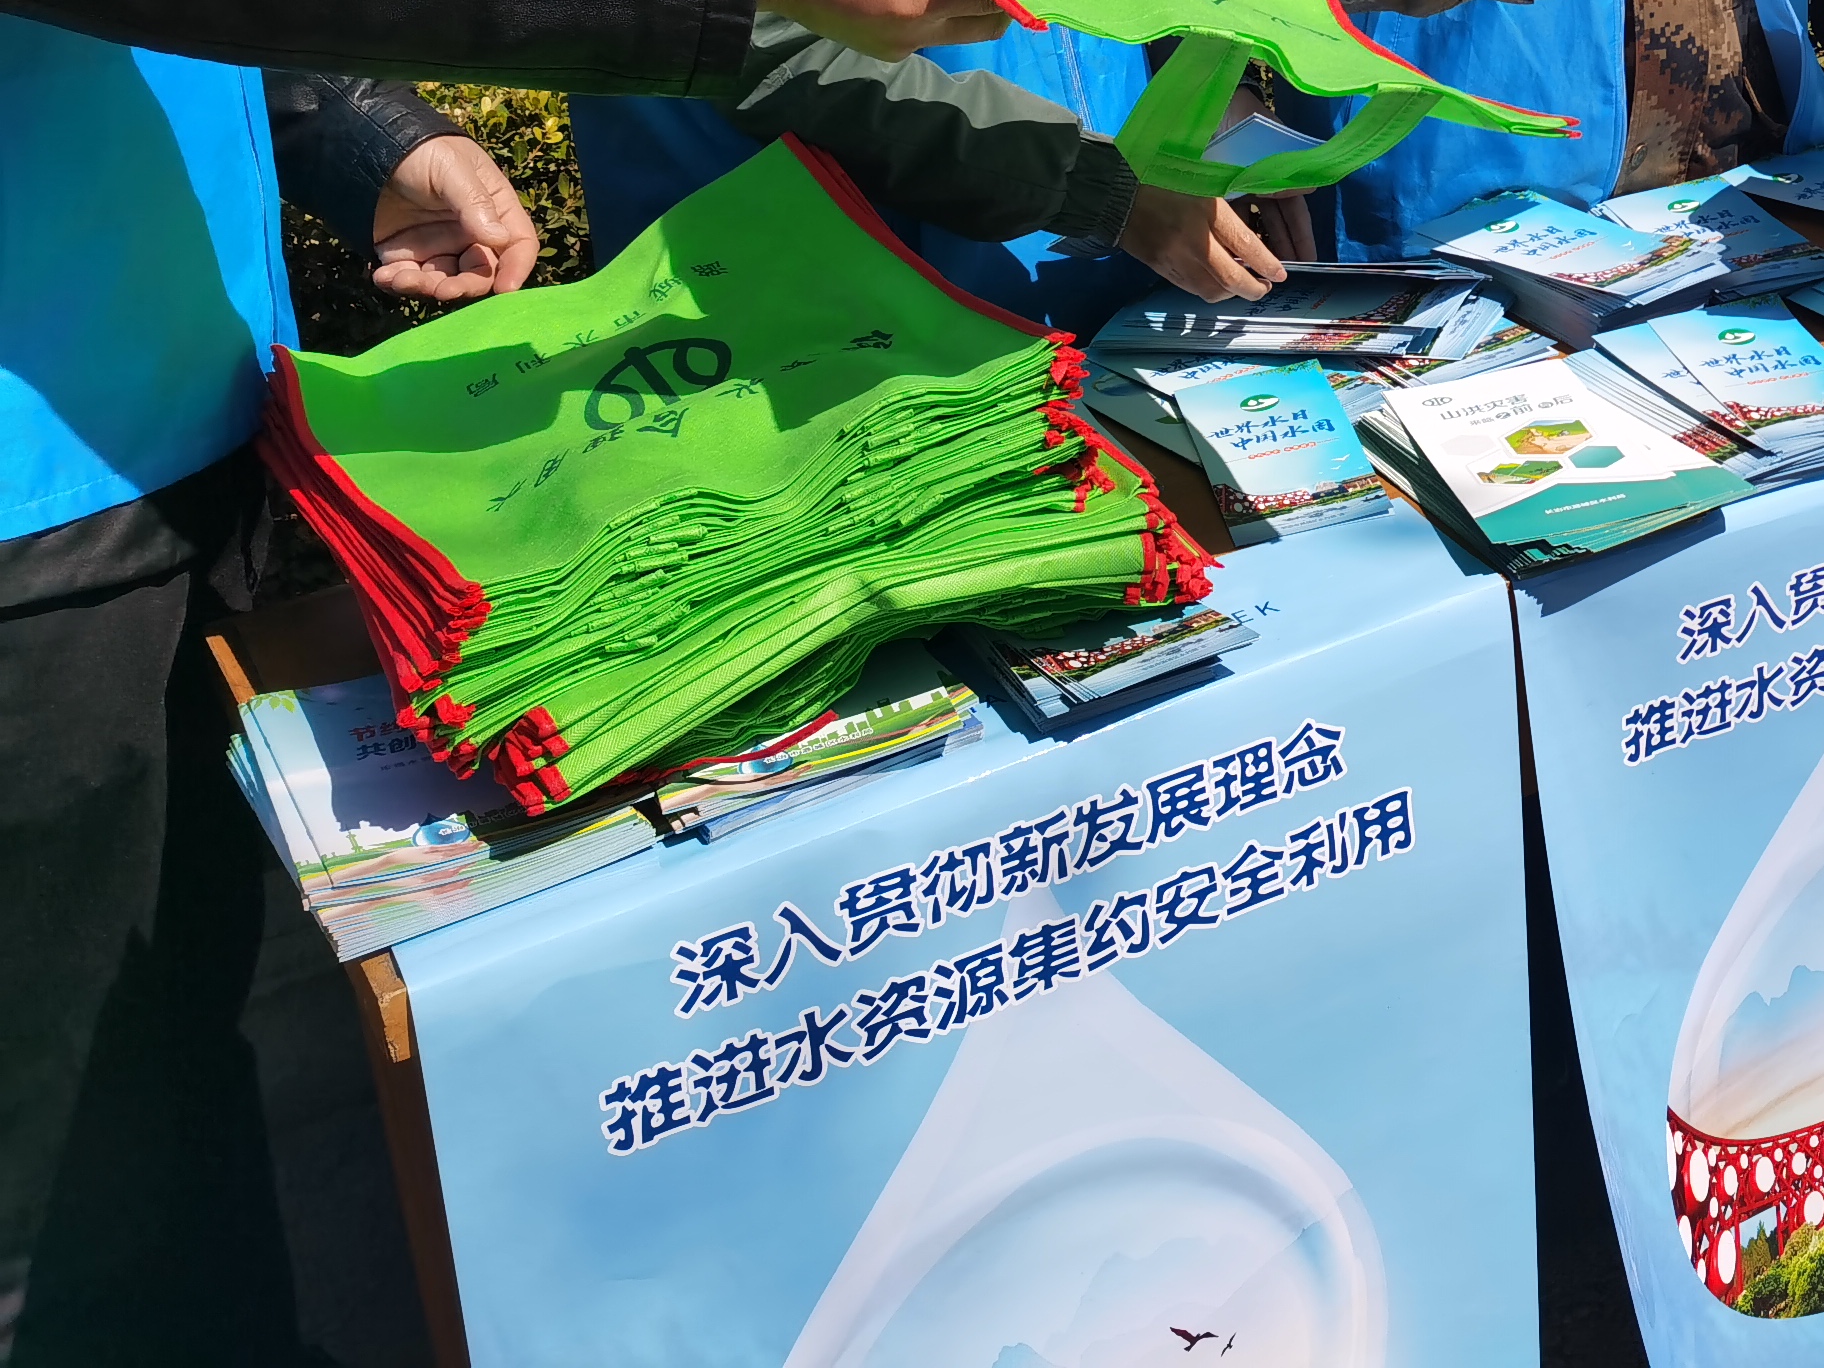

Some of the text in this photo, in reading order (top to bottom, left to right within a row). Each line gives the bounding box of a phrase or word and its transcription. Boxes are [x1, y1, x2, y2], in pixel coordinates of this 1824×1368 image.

[1493, 226, 1564, 253] 世界水日
[1520, 228, 1598, 256] 中国水周
[1700, 345, 1793, 368] 世界水日
[1725, 354, 1823, 379] 中国水周
[1439, 393, 1528, 421] 山洪灾害
[1207, 409, 1310, 439] 世界水日
[1231, 418, 1336, 451] 中国水周
[673, 720, 1346, 1016] 深入贯彻新发展理念
[602, 788, 1414, 1154] 推进水资源集约安全利用
